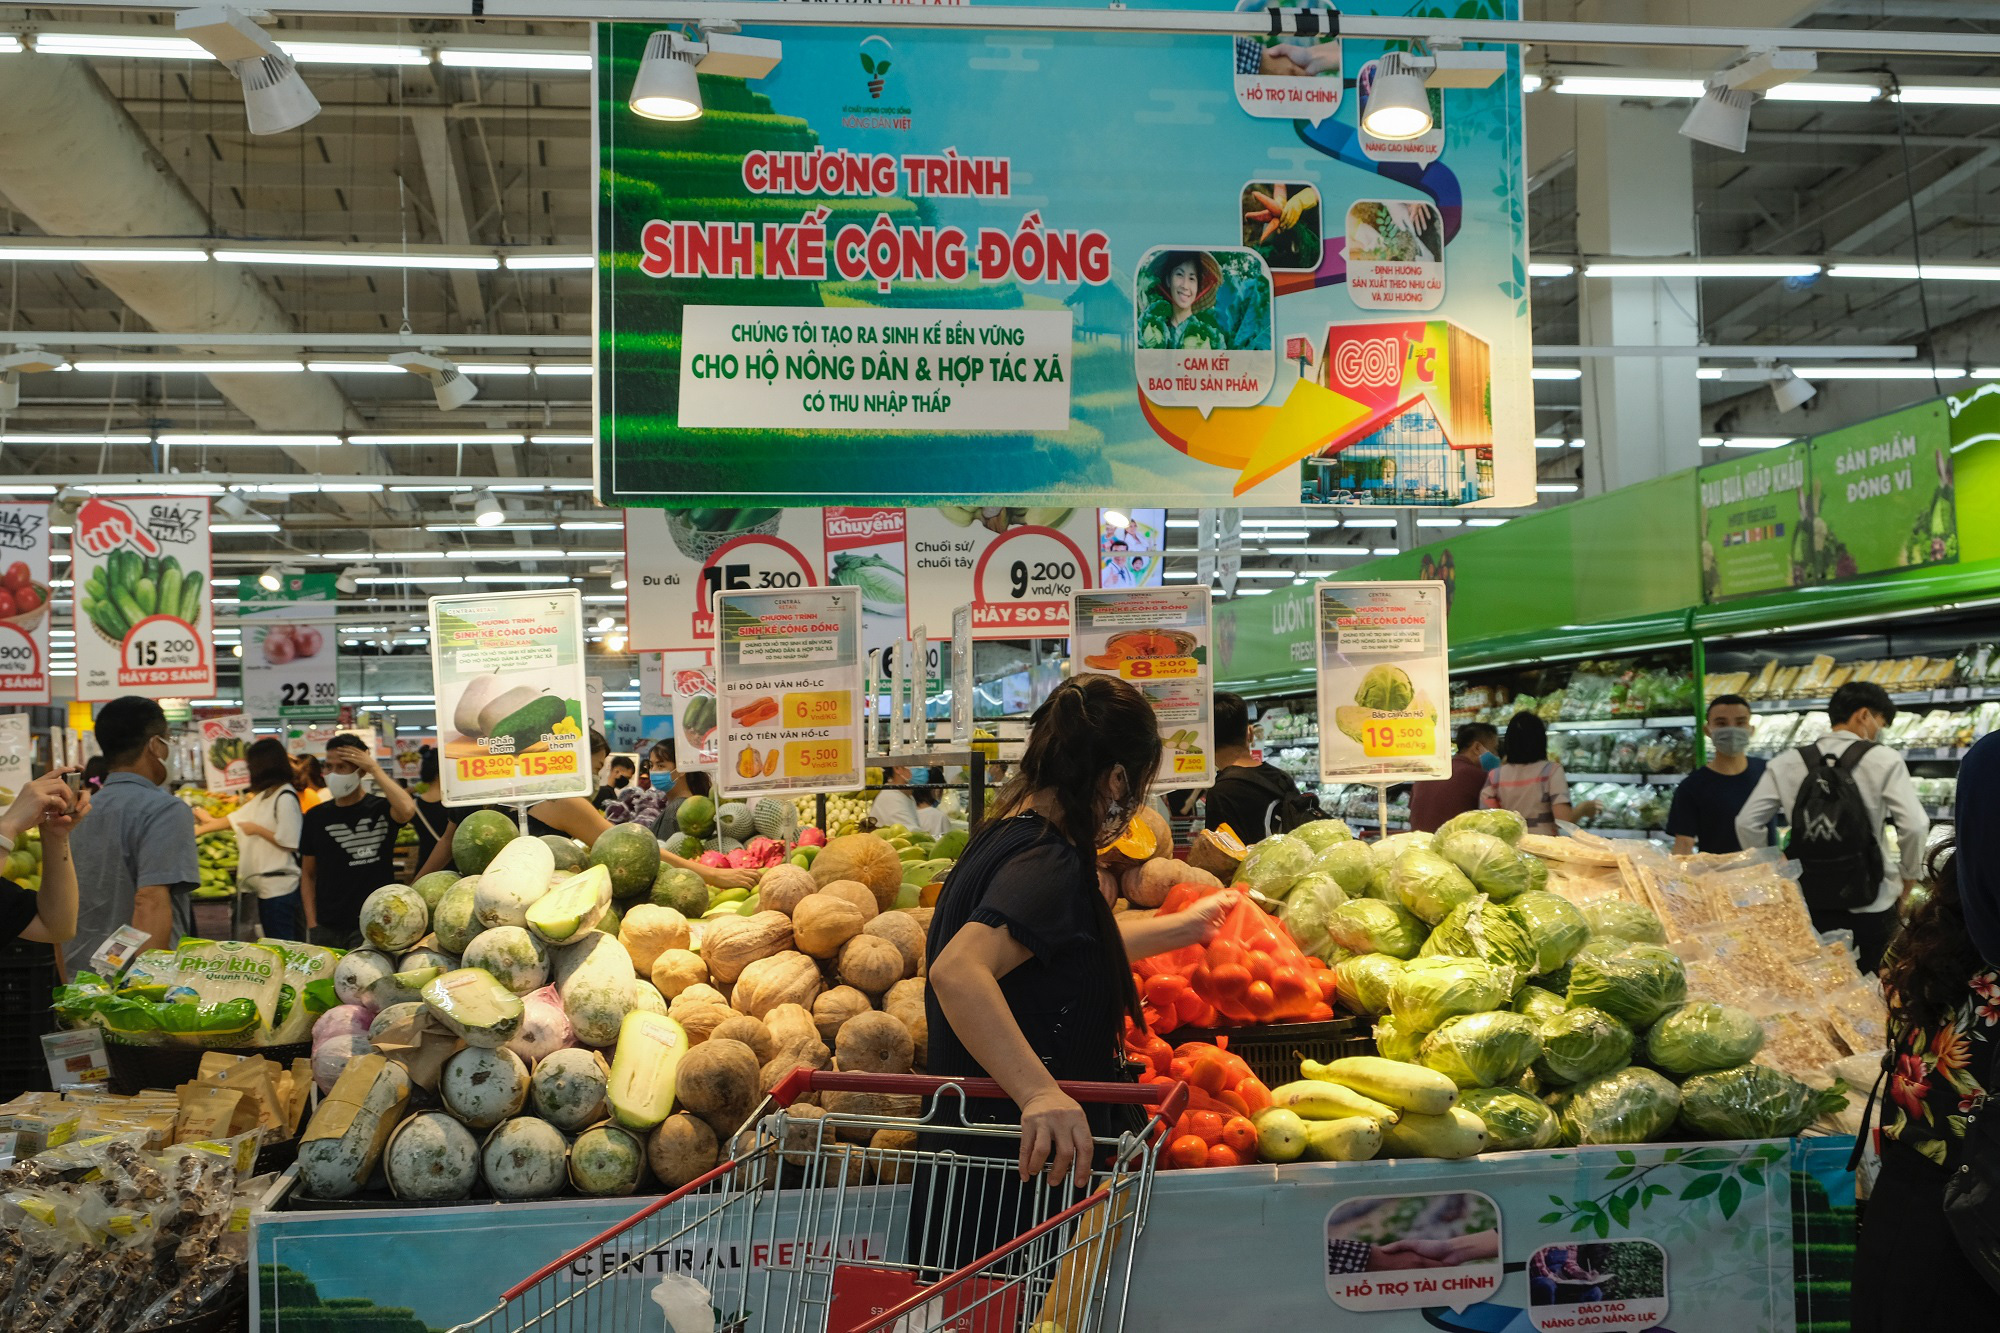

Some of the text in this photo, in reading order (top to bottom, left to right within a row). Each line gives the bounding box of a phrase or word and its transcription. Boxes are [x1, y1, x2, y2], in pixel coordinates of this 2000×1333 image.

[1247, 83, 1337, 104] HỖ TRỢ TÀI CHÍNH
[842, 114, 912, 132] NÔNG DÂN VIỆT
[1388, 143, 1402, 152] CAO
[743, 147, 1009, 196] CHƯƠNG TRÌNH
[641, 205, 1111, 291] SINH KẾ CỘNG ĐỒNG
[1389, 279, 1407, 289] THEO
[731, 319, 1025, 348] CHÚNG TÔI TẠO RA SINH KẾ BỀN VỮNG
[691, 348, 1064, 388] CHO HỘ NÔNG DÂN & HỢP TÁC XÃ
[1184, 352, 1230, 371] CAM KẾT
[1335, 337, 1401, 388] GO!
[1148, 371, 1259, 392] BAO TIÊU SẢN PHẨM
[802, 387, 951, 417] CÓ THU NHẬP THẤP
[1836, 431, 1917, 475] SẢN PHẨM
[150, 502, 181, 520] GIÁ
[915, 539, 976, 553] Chuối sứ/
[917, 556, 974, 570] chuối tây
[642, 573, 681, 586] Đu đủ
[1010, 559, 1029, 599] 9
[1031, 582, 1072, 596] vnd/Kg
[795, 612, 818, 620] TRÌNH
[973, 604, 1070, 623] HÃY SO SÁ
[1272, 592, 1305, 635] LUÔN
[1337, 617, 1358, 625] SINH
[454, 630, 478, 640] SINH
[738, 621, 839, 636] SINH KẾ CỘNG ĐỒNG
[135, 639, 195, 666] 15 200
[149, 672, 169, 683] SO
[1129, 660, 1153, 678] 8
[1156, 667, 1197, 675] vnd/kg
[727, 678, 825, 691] BÍ ĐỎ DÀI VÂN HỒ-LC
[281, 682, 310, 706] 22
[796, 700, 838, 718] 6 .500
[810, 713, 837, 721] Vnd/KG
[478, 737, 489, 746] Bí
[541, 732, 576, 742] Bí xanh
[728, 728, 830, 742] BÍ CÔ TIÊN VÂN HỒ-LC
[1367, 726, 1423, 748] 19 .500
[549, 740, 574, 749] thơm
[1396, 740, 1426, 750] vnd/kg
[521, 756, 548, 776] 15
[799, 748, 839, 767] 5 .500
[811, 761, 838, 769] Vnd/KG
[1176, 757, 1185, 771] 7
[459, 758, 486, 778] 18
[227, 954, 273, 977] khô
[1346, 1274, 1495, 1299] HỖ TRỢ TÀI CHÍNH
[1578, 1303, 1603, 1315] ĐÀO
[1541, 1317, 1575, 1329] NÂNG
[1577, 1316, 1600, 1326] CAO
[1638, 1311, 1657, 1324] LỰC
